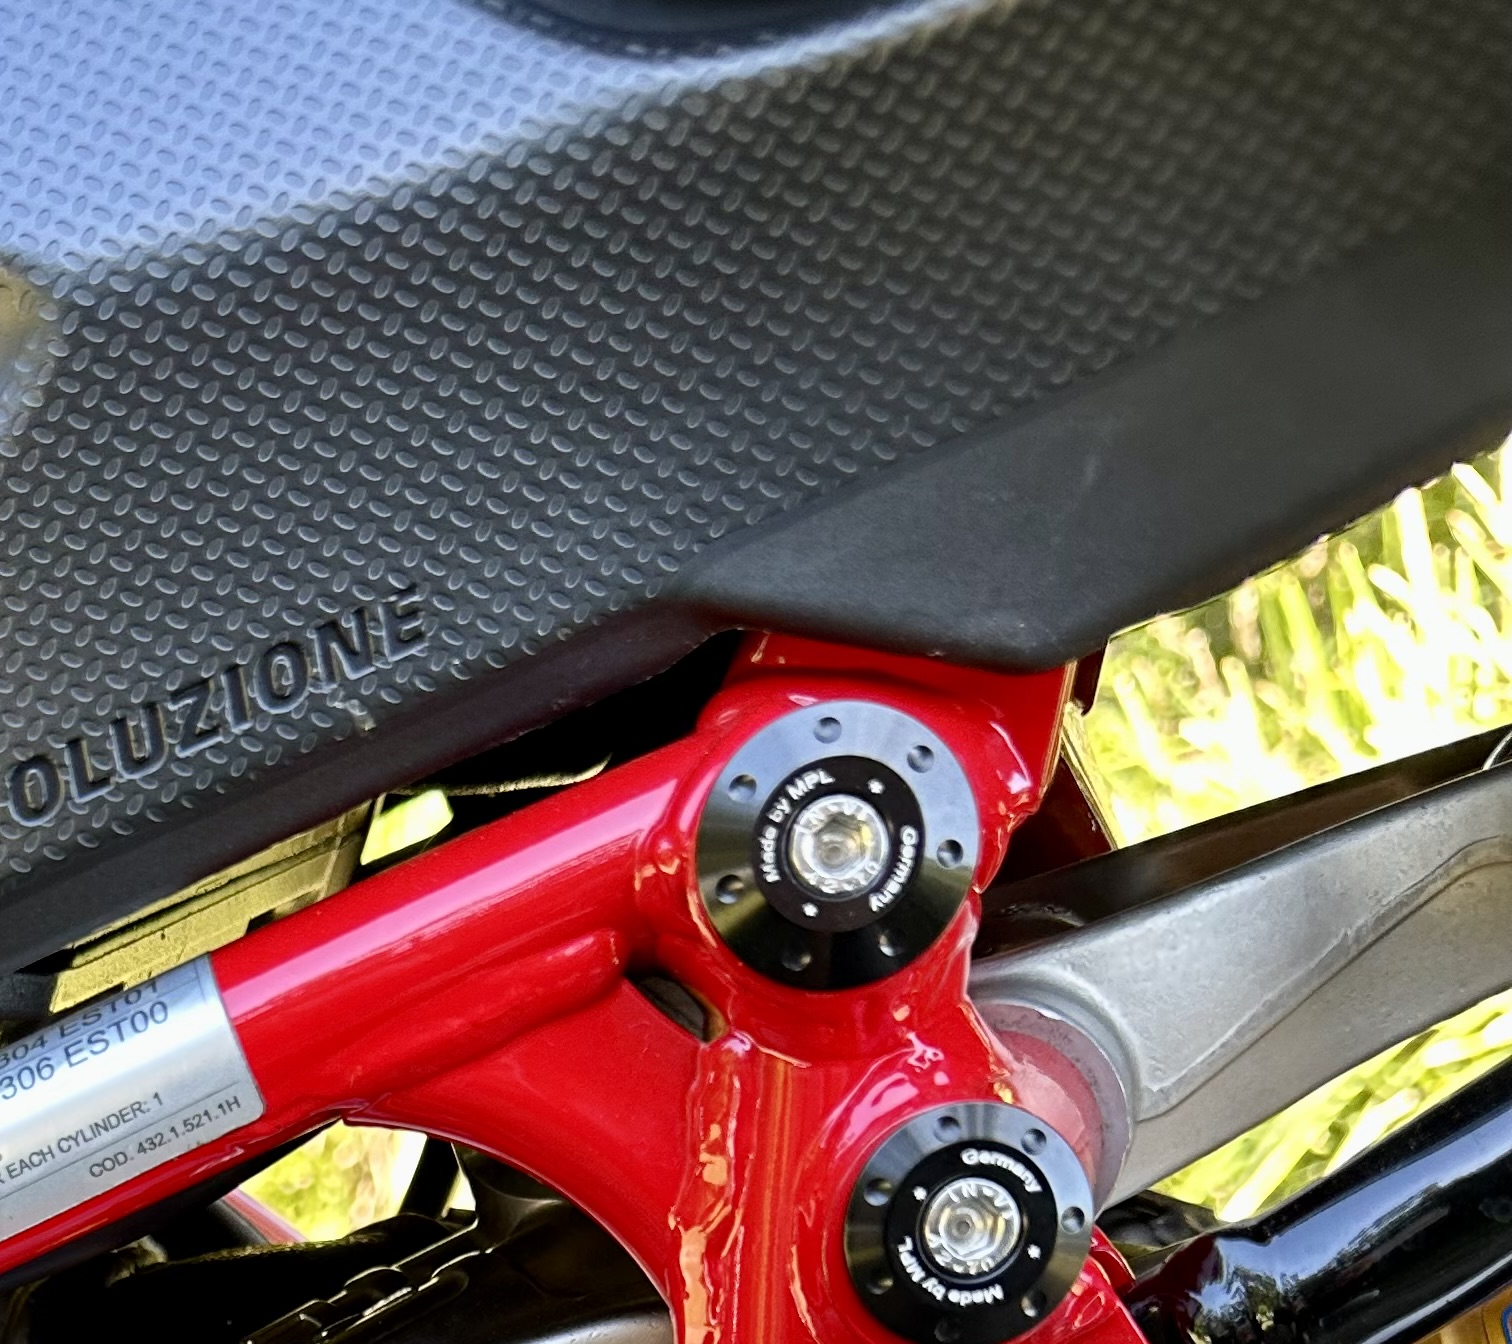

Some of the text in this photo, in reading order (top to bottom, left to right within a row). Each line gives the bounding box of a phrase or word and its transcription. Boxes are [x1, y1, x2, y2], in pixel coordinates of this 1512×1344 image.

[758, 768, 836, 883] Made by MPL
[868, 824, 919, 913] Germany
[63, 1000, 169, 1068] EST00
[8, 1145, 55, 1180] EACH
[57, 1100, 151, 1154] CYLINDER:
[152, 1092, 163, 1106] 1
[89, 1095, 241, 1178] COD. 432.1.521.1H
[960, 1147, 1043, 1193] Germany
[897, 1236, 1004, 1307] Made by MPL
